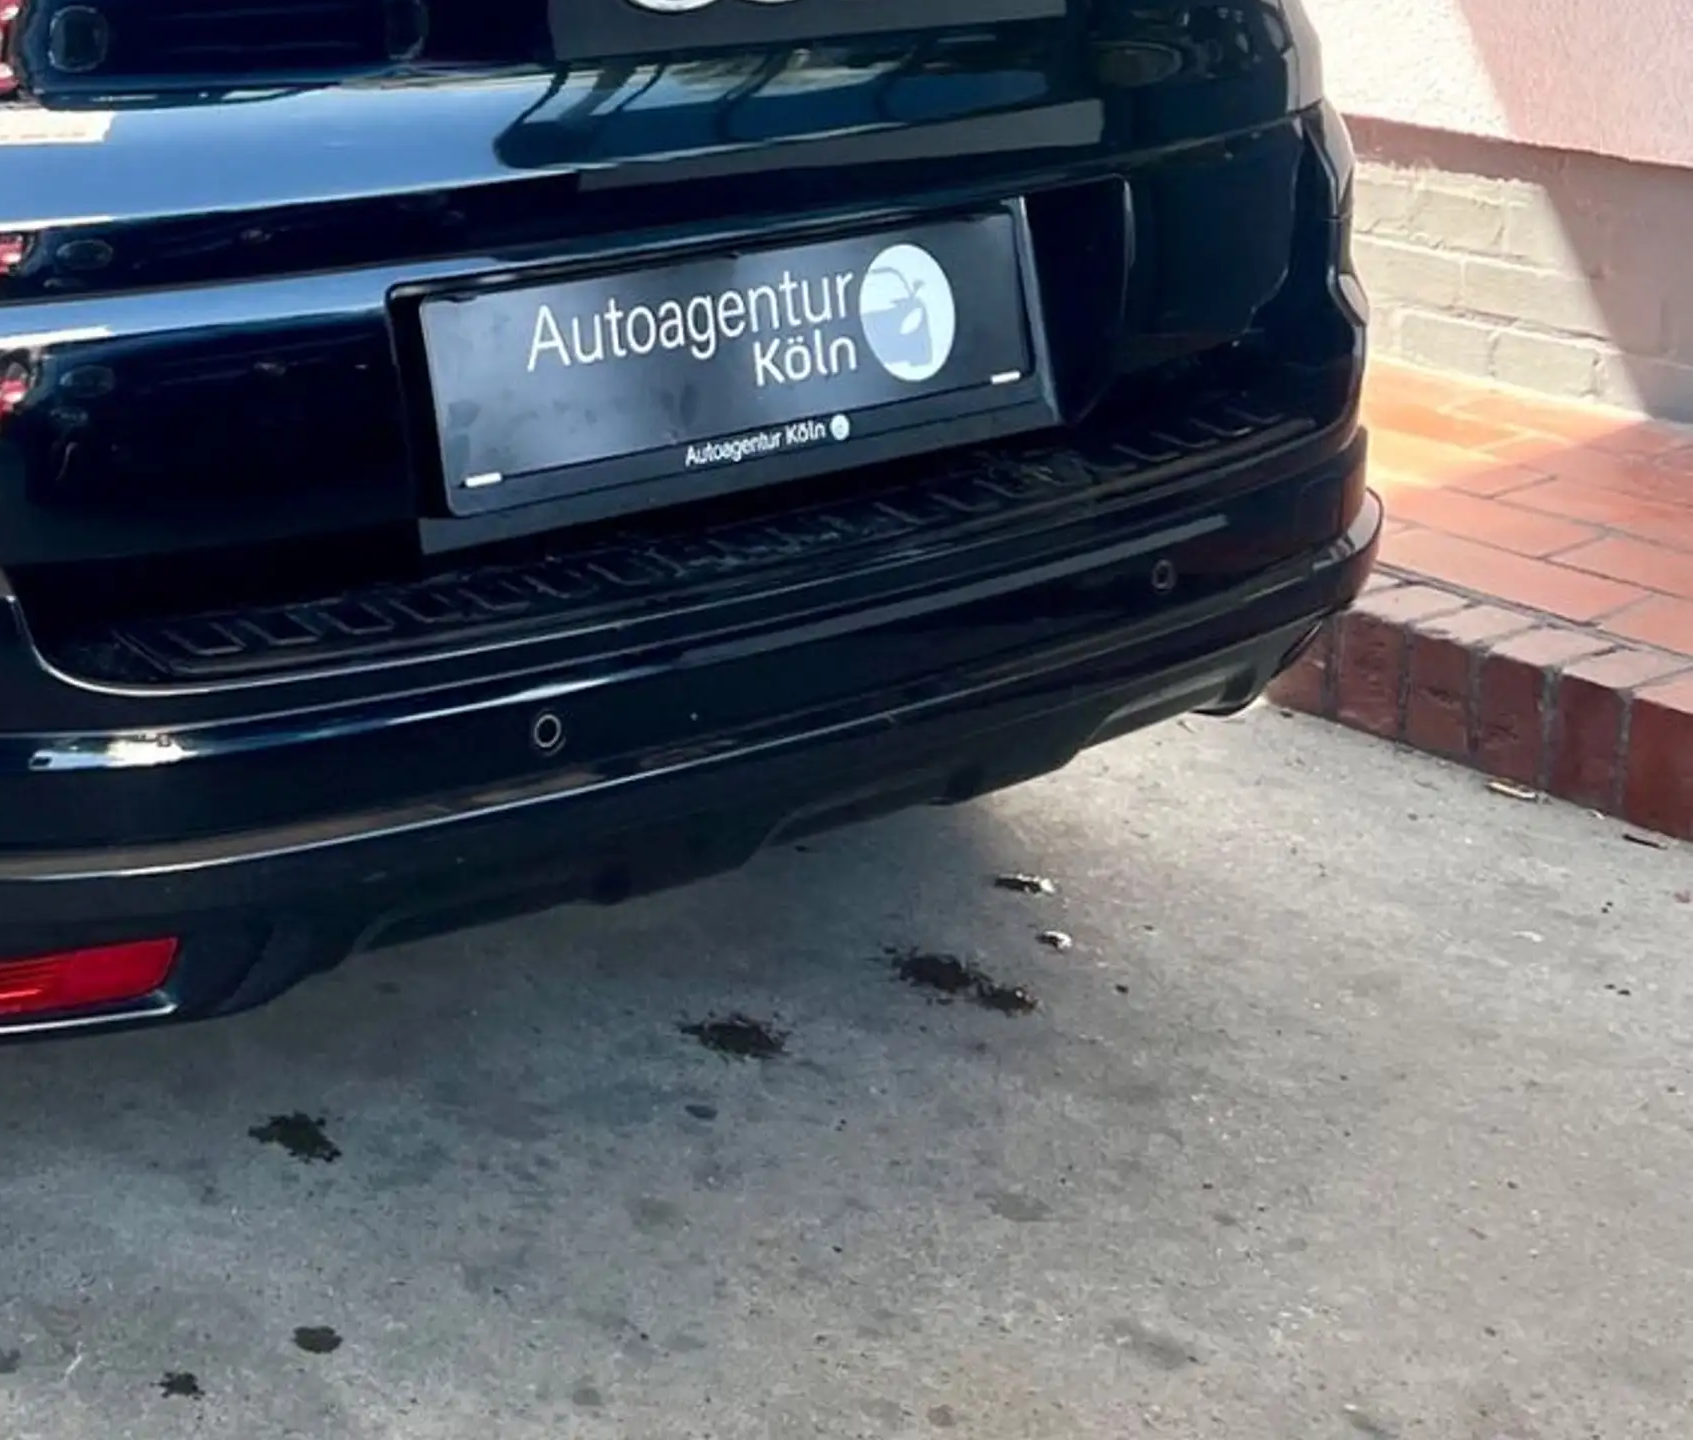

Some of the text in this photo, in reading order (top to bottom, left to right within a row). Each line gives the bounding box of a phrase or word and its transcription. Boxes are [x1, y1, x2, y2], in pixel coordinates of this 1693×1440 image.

[527, 270, 855, 372] Autoagentur
[753, 333, 859, 387] Köln
[685, 421, 826, 468] Autoagentur Köln
